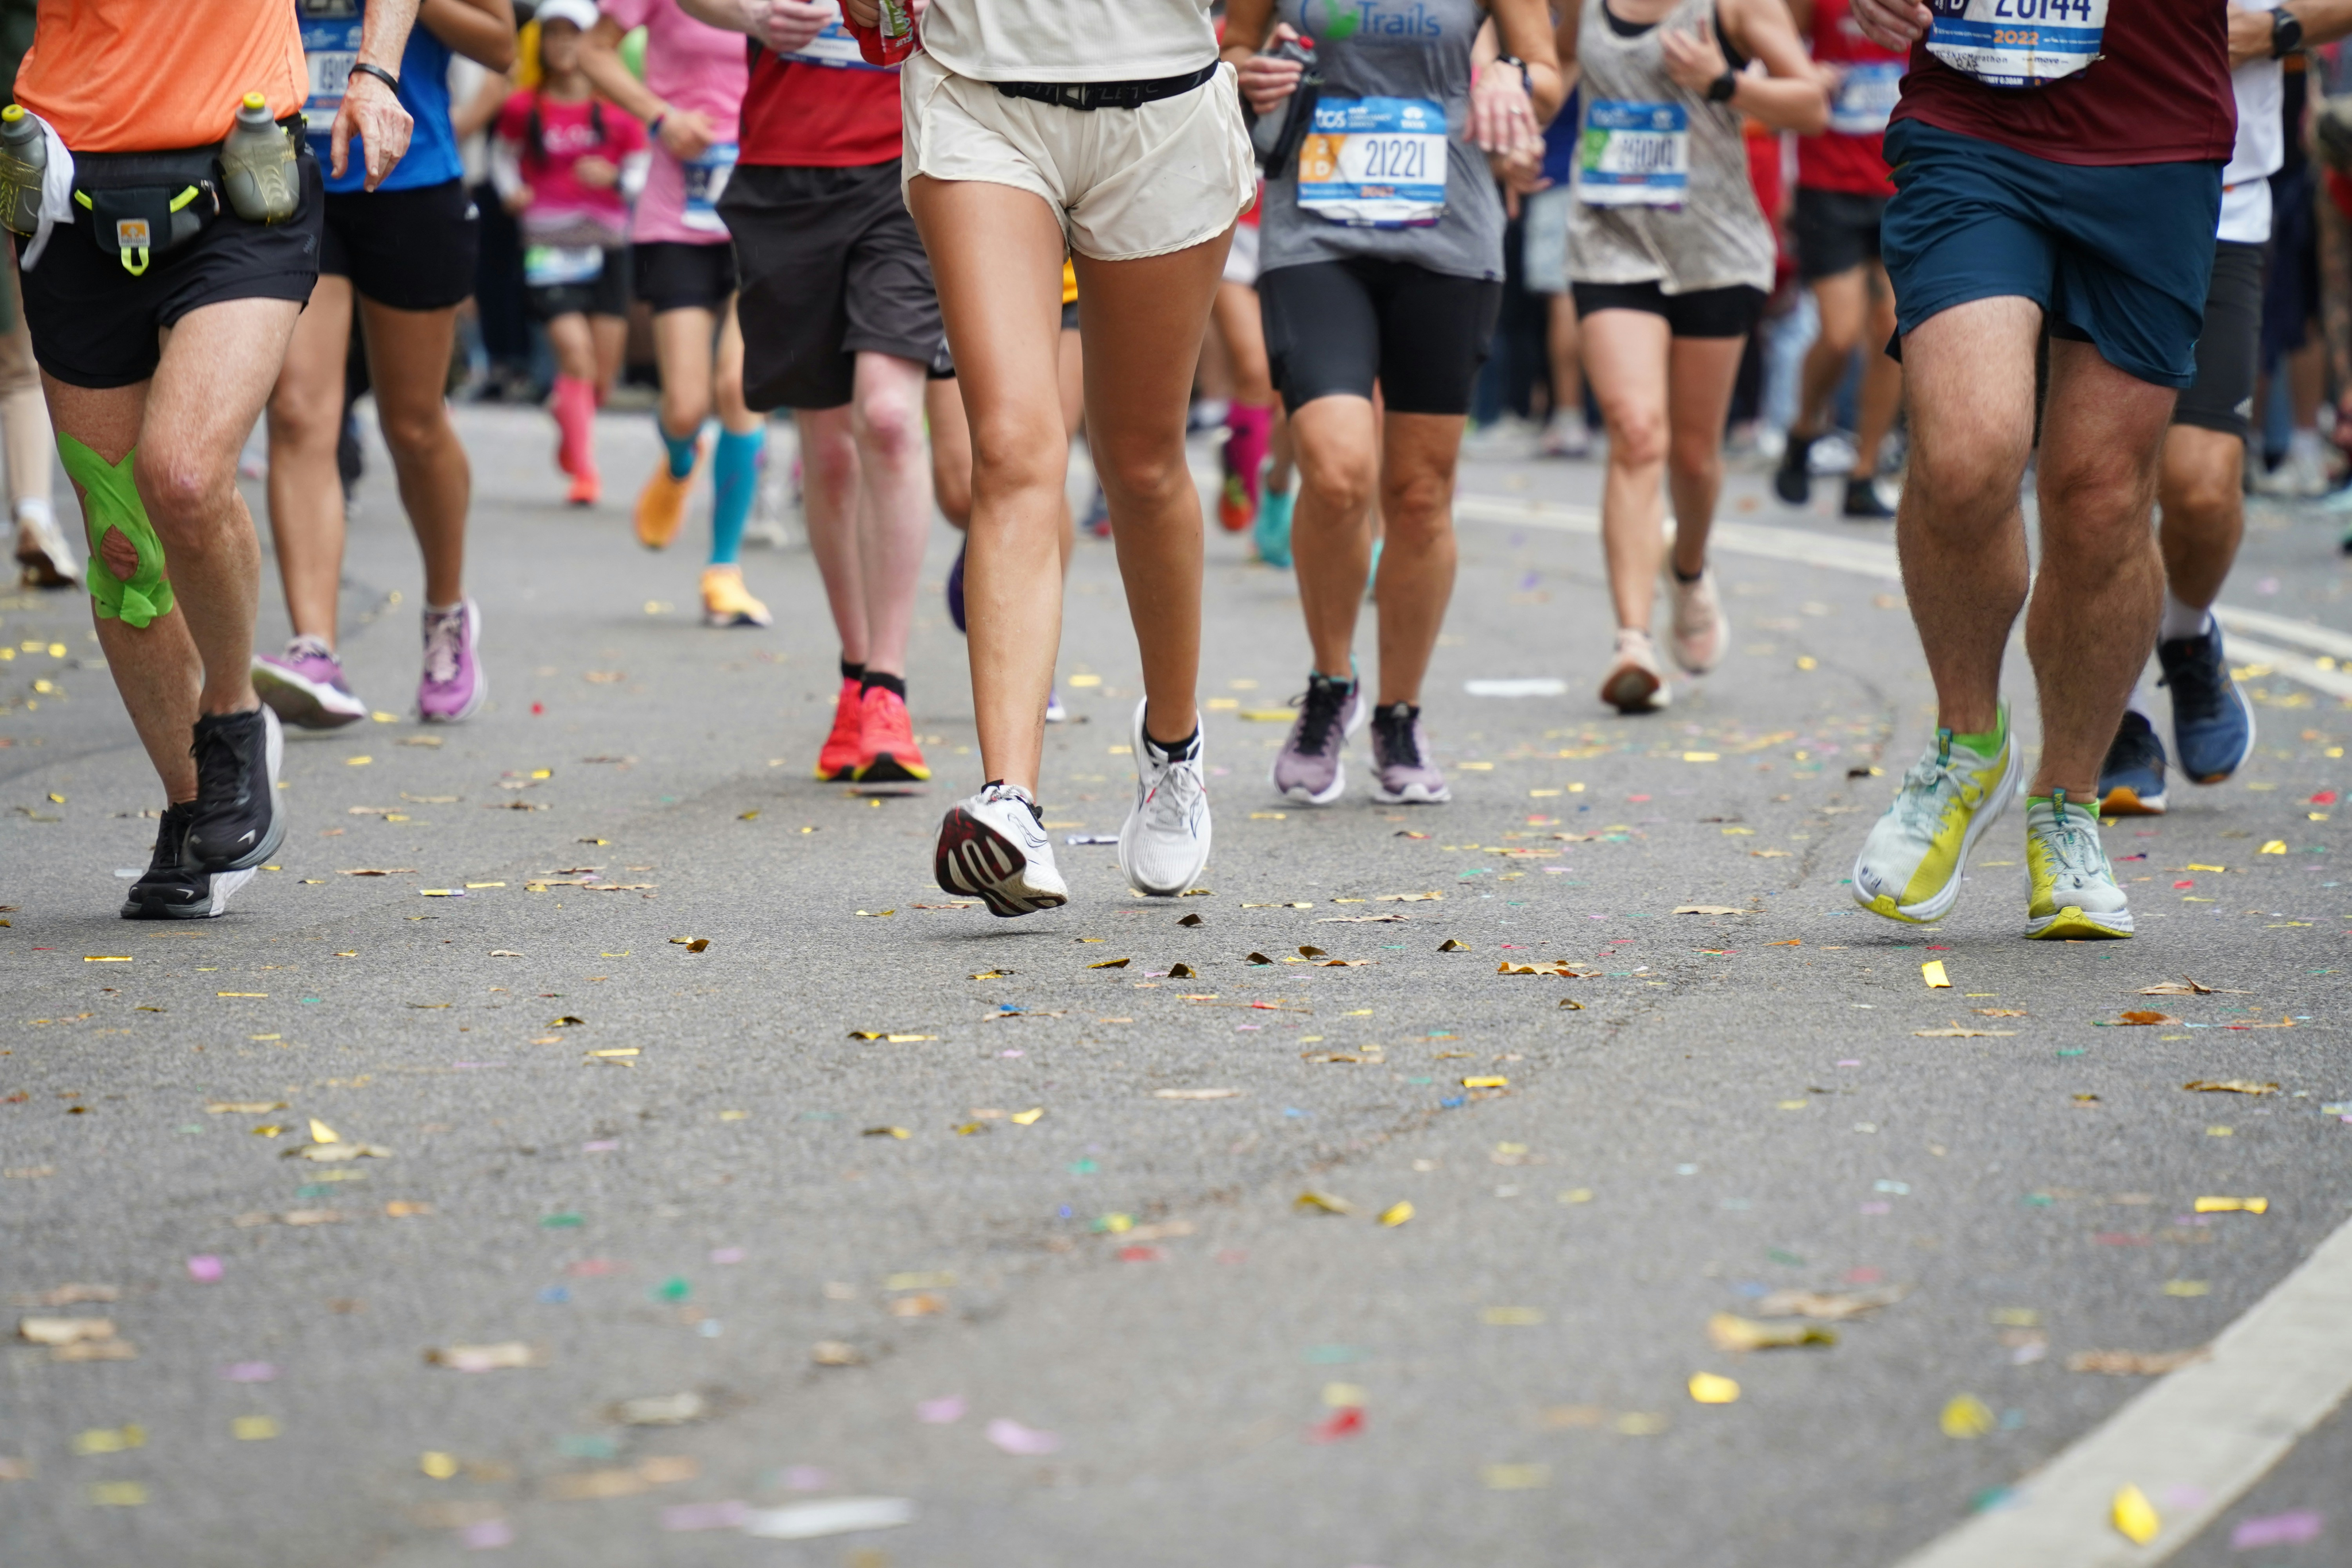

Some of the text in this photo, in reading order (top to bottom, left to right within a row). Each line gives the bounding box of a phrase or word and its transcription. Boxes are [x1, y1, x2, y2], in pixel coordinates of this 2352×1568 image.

[1356, 2, 1441, 36] Trails
[1993, 29, 2038, 45] 2022
[1365, 140, 1425, 178] 21221
